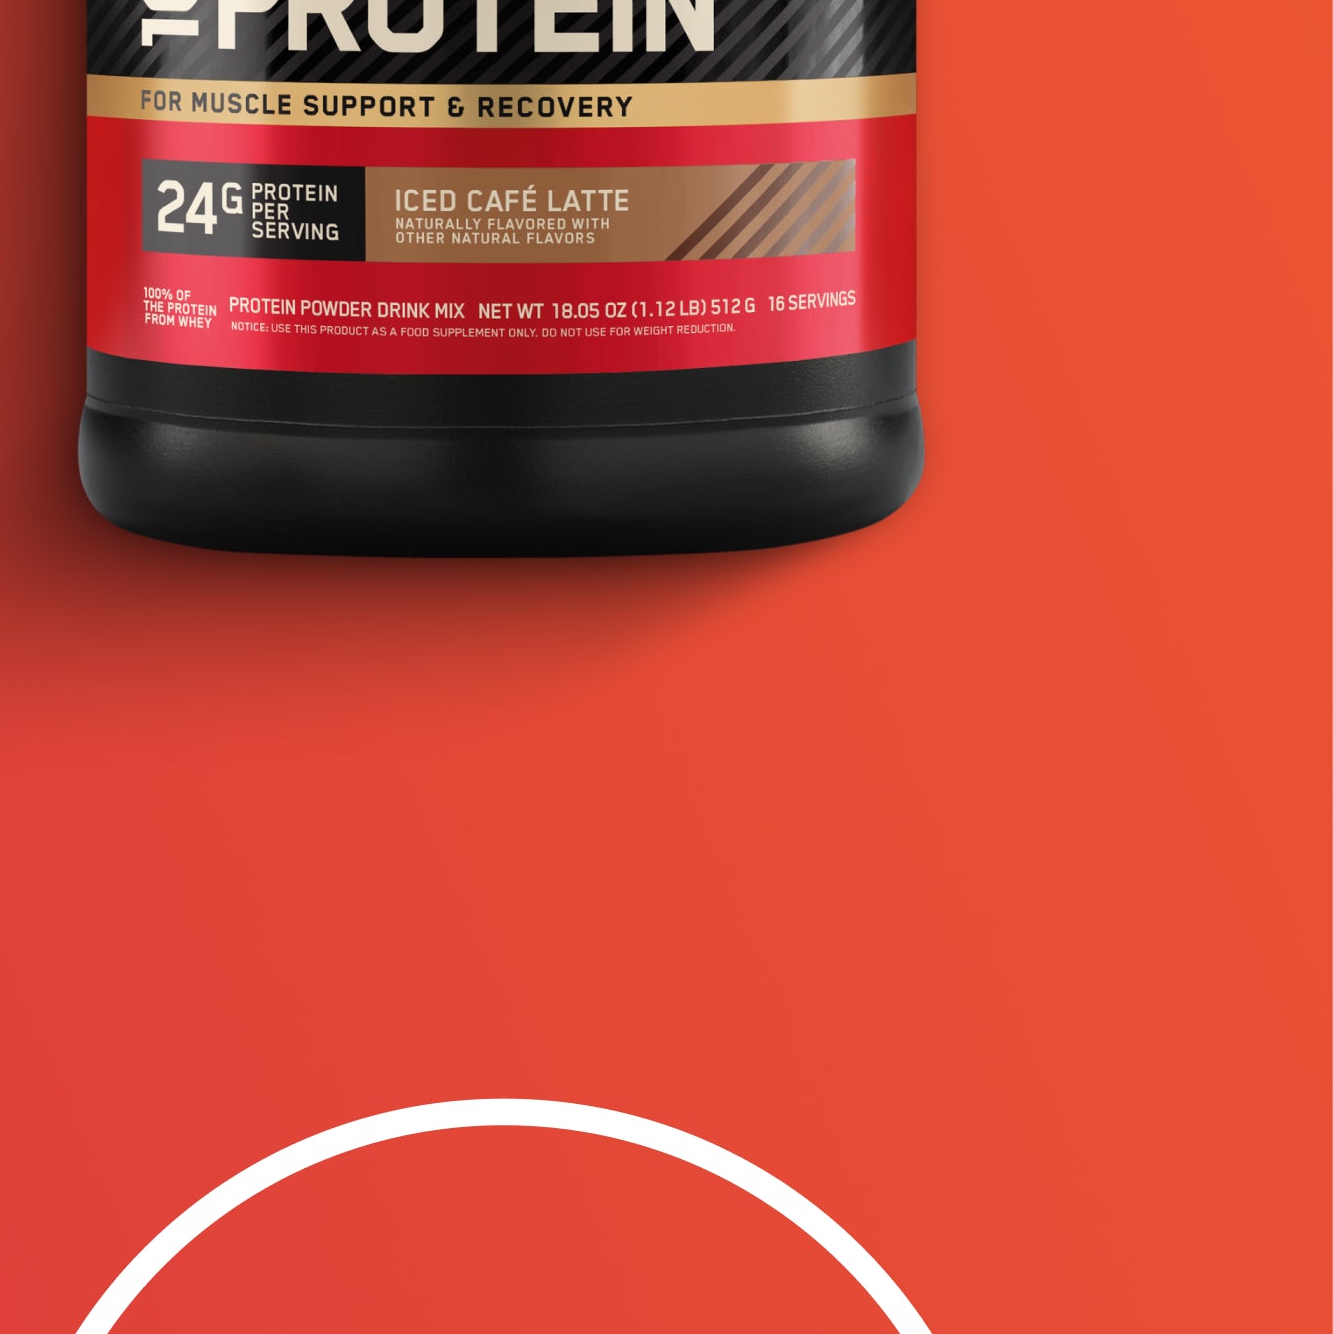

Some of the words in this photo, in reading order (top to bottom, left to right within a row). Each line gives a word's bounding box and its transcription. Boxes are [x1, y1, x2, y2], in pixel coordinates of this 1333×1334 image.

[140, 90, 180, 113] FOR
[192, 92, 291, 116] MUSCLE
[303, 94, 435, 118] SUPPORT
[447, 96, 465, 118] &
[478, 96, 633, 118] RECOVERY
[251, 182, 338, 202] PROTEIN
[395, 188, 456, 212] ICED
[467, 184, 537, 212] CAFÉ
[547, 188, 629, 212] LATTE
[251, 202, 289, 221] PER
[251, 221, 339, 241] SERVING
[395, 217, 482, 230] NATURALLY
[487, 218, 566, 230] FLAVORED
[571, 217, 610, 230] WITH
[395, 231, 445, 244] OTHER
[451, 232, 520, 244] NATURAL
[526, 232, 595, 244] FLAVORS
[143, 286, 173, 300] 100%
[176, 289, 191, 301] OF
[143, 299, 164, 313] THE
[167, 301, 217, 316] PROTEIN
[229, 296, 296, 315] PROTEIN
[300, 299, 372, 318] POWDER
[377, 301, 430, 319] DRINK
[434, 302, 465, 319] MIX
[478, 302, 513, 319] NET
[516, 302, 544, 319] WT
[552, 302, 600, 319] 18.05
[604, 301, 627, 318] OZ
[631, 300, 675, 318] (1.12
[679, 298, 707, 317] LB)
[710, 297, 741, 315] 512
[744, 297, 756, 313] G
[768, 295, 785, 312] 16
[788, 289, 856, 311] SERVINGS
[144, 312, 175, 326] FROM
[178, 316, 212, 329] WHEY
[231, 321, 269, 332] NOTICE:
[271, 323, 291, 334] USE
[294, 324, 318, 335] THIS
[319, 325, 369, 336] PRODUCT
[371, 326, 387, 337] AS
[400, 327, 430, 337] FOOD
[432, 327, 505, 338] SUPPLEMENT
[508, 328, 539, 338] ONLY.
[541, 328, 557, 338] DO
[560, 327, 582, 338] NOT
[584, 327, 606, 337] USE
[609, 326, 631, 337] FOR
[633, 325, 674, 336] WEIGHT
[676, 323, 736, 335] REDUCTION.
